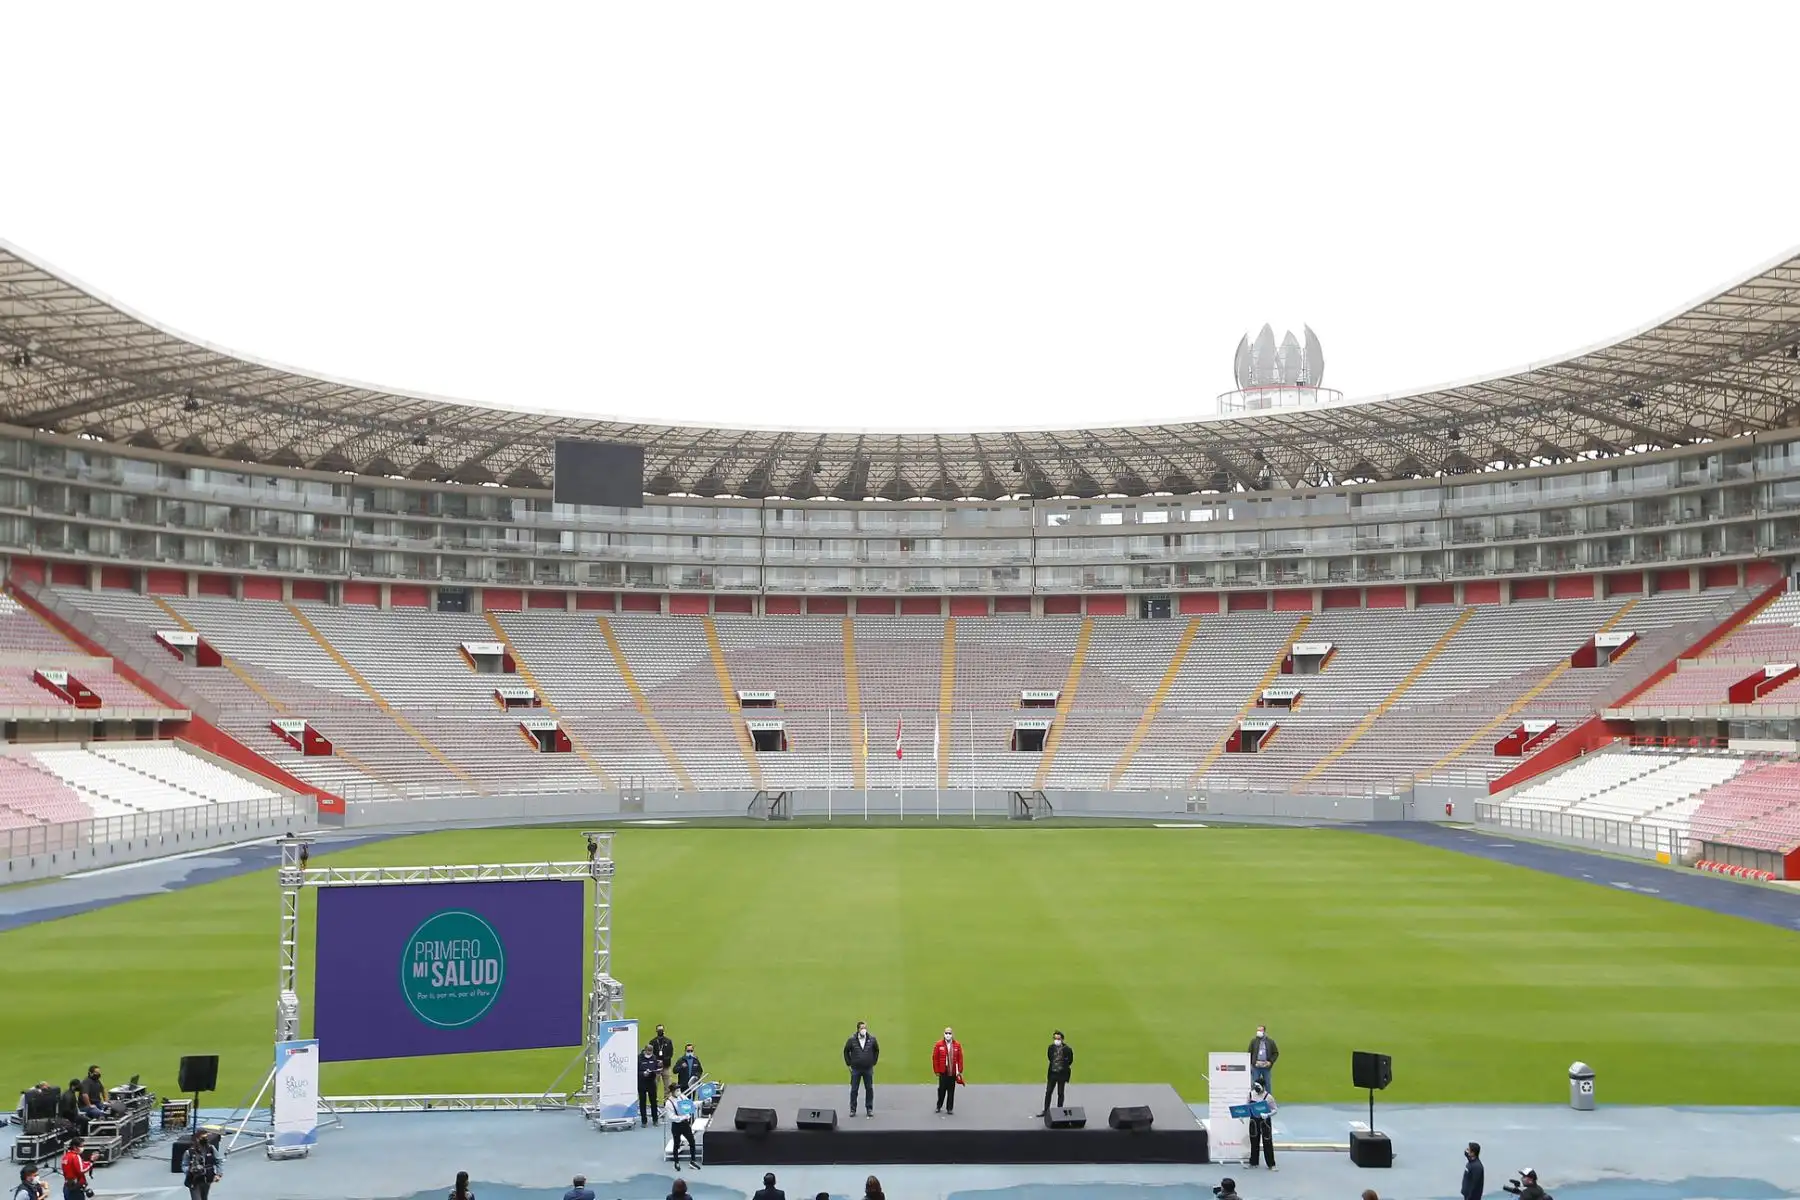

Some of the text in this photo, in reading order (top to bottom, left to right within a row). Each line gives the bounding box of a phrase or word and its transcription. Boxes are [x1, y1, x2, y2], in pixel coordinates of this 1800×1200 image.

[415, 939, 480, 960] PRIMERO
[413, 959, 498, 987] MI SALUD
